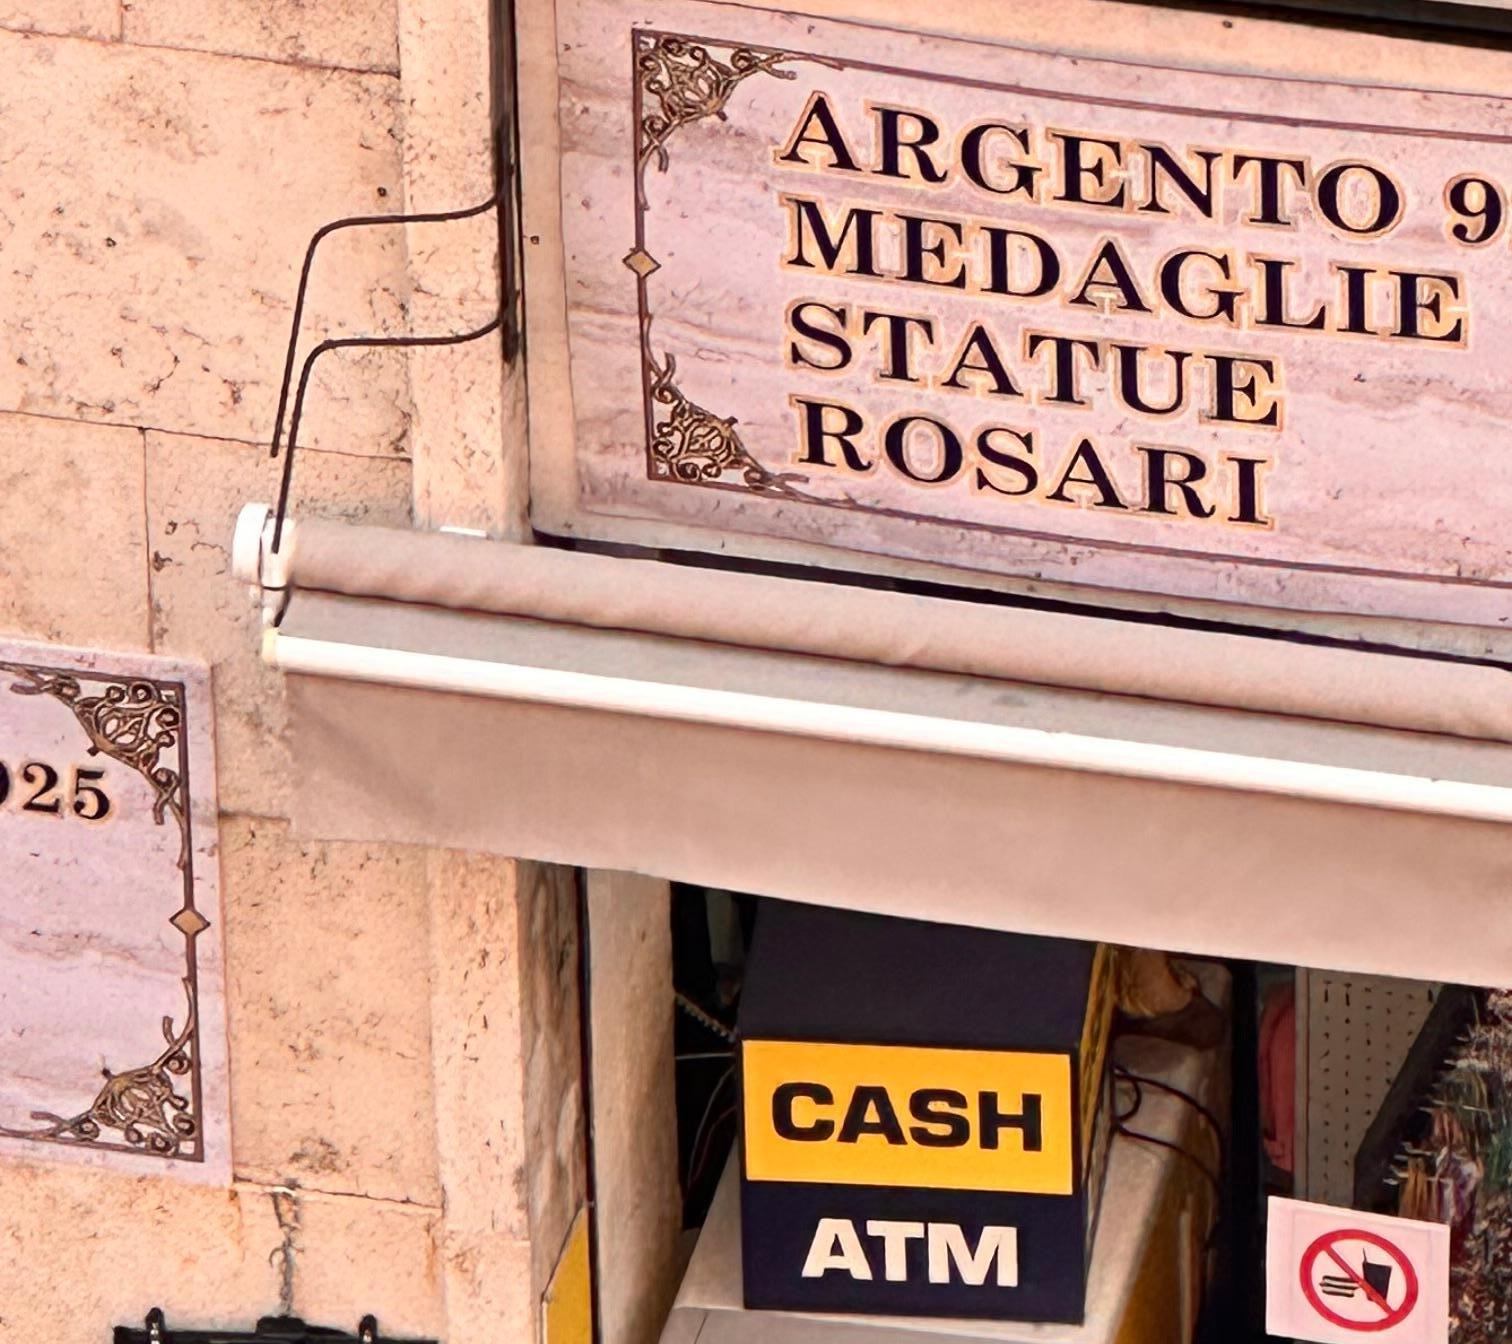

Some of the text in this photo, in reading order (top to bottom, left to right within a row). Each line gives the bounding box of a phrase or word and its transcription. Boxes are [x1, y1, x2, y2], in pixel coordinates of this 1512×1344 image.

[780, 90, 1404, 238] ARGENTO
[784, 196, 1467, 346] MEDAGLIE
[787, 300, 1283, 428] STATUE
[798, 397, 1273, 528] ROSARI
[771, 1082, 1042, 1152] CASH
[801, 1218, 1018, 1287] ATM
